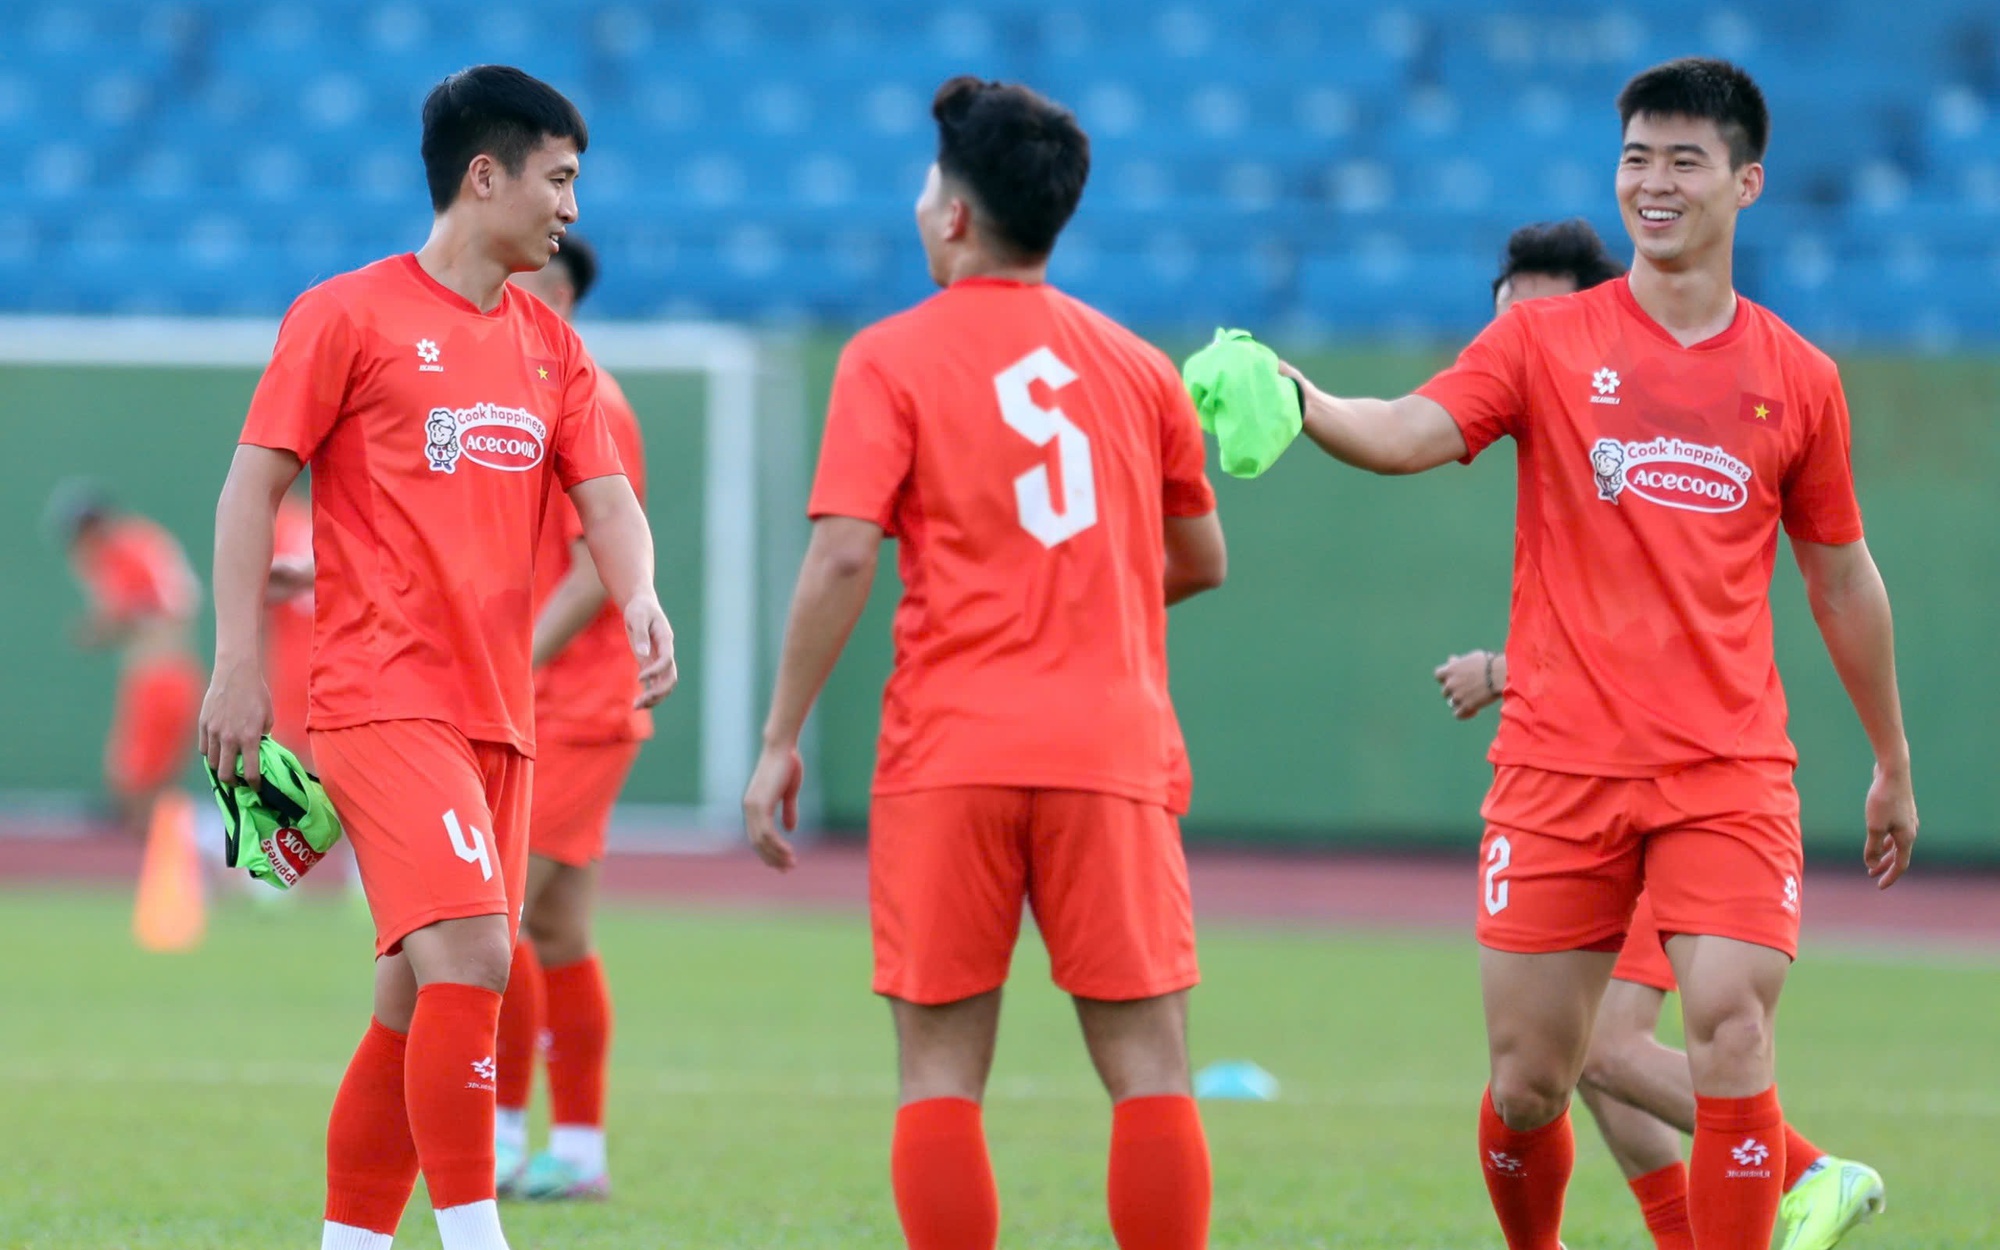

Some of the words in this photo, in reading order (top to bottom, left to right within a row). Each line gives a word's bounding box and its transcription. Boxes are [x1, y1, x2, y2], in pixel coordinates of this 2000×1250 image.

[457, 405, 488, 425] Cook
[490, 405, 545, 438] happiness
[993, 345, 1098, 550] 5
[1627, 441, 1668, 459] Cook
[1674, 442, 1750, 481] happiness
[442, 808, 494, 883] 4
[1485, 835, 1511, 916] 2
